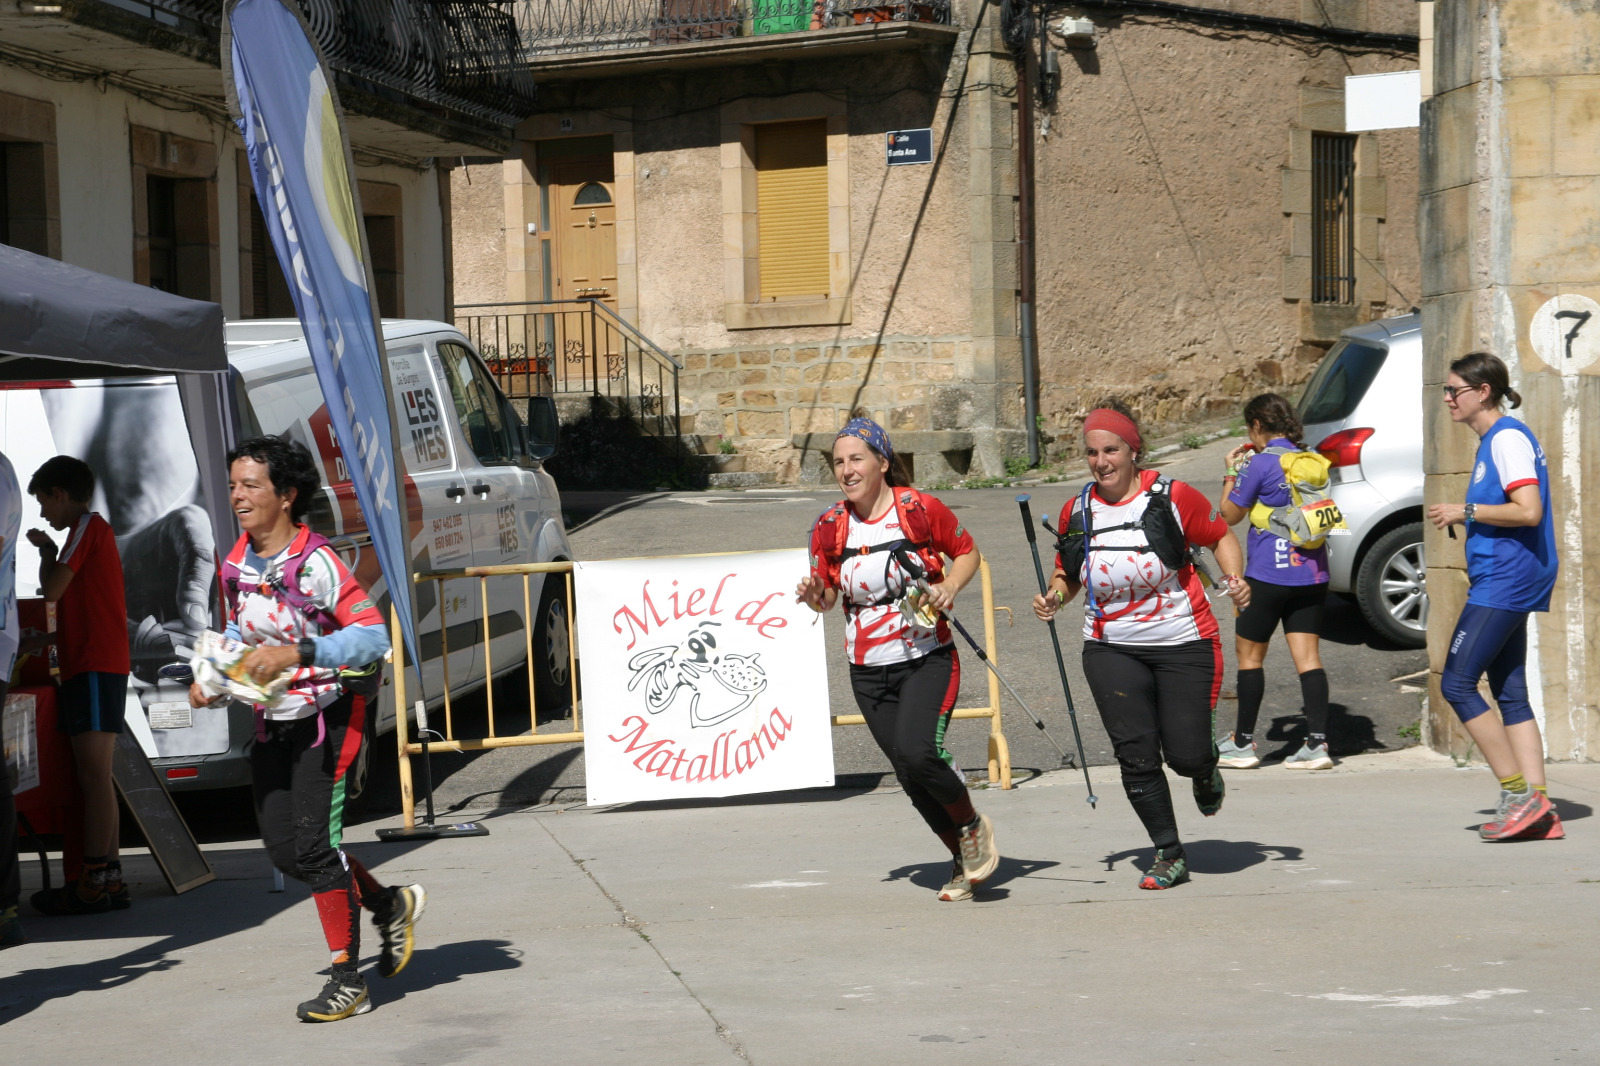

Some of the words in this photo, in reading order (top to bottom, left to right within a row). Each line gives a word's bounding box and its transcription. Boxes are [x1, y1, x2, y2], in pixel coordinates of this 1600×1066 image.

[888, 149, 905, 157] Santa
[905, 148, 917, 156] Ana
[1554, 310, 1592, 358] 7
[411, 425, 447, 463] MES
[433, 518, 443, 533] 947
[443, 515, 453, 530] 462
[1315, 506, 1343, 528] 203
[434, 535, 445, 550] 650
[453, 531, 464, 545] 724
[499, 528, 519, 555] MES
[613, 573, 737, 651] Miel
[735, 592, 788, 639] de
[608, 706, 793, 783] Matallana
